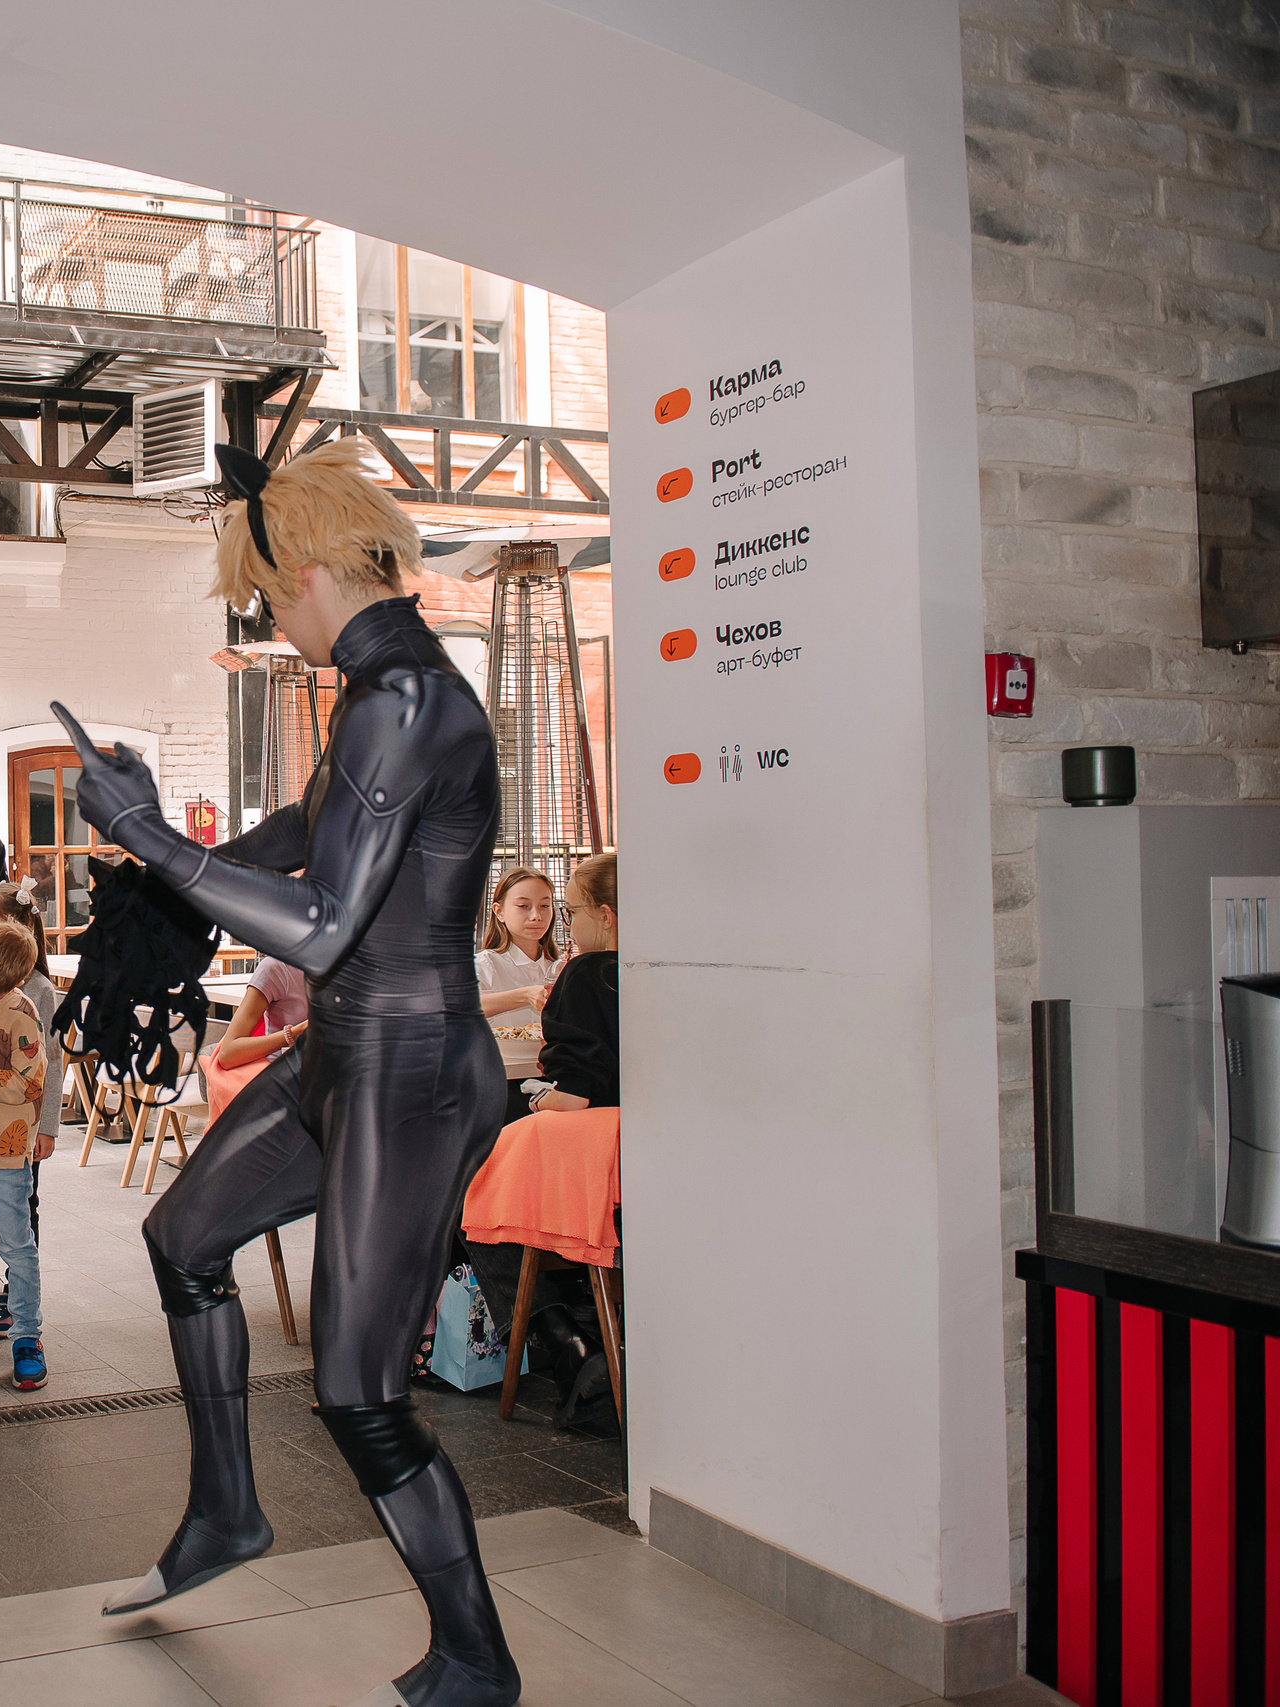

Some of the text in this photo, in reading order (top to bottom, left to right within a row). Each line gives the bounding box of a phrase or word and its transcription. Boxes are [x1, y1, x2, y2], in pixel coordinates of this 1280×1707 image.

[709, 359, 783, 402] Карма
[709, 380, 806, 427] бургер-бар
[711, 448, 762, 484] Port
[712, 455, 847, 508] стейк-ресторан
[714, 526, 811, 570] Диккенс
[714, 555, 808, 591] lounge club
[715, 620, 783, 647] Чехов
[716, 646, 802, 676] арт-буфет
[757, 748, 790, 770] WC
